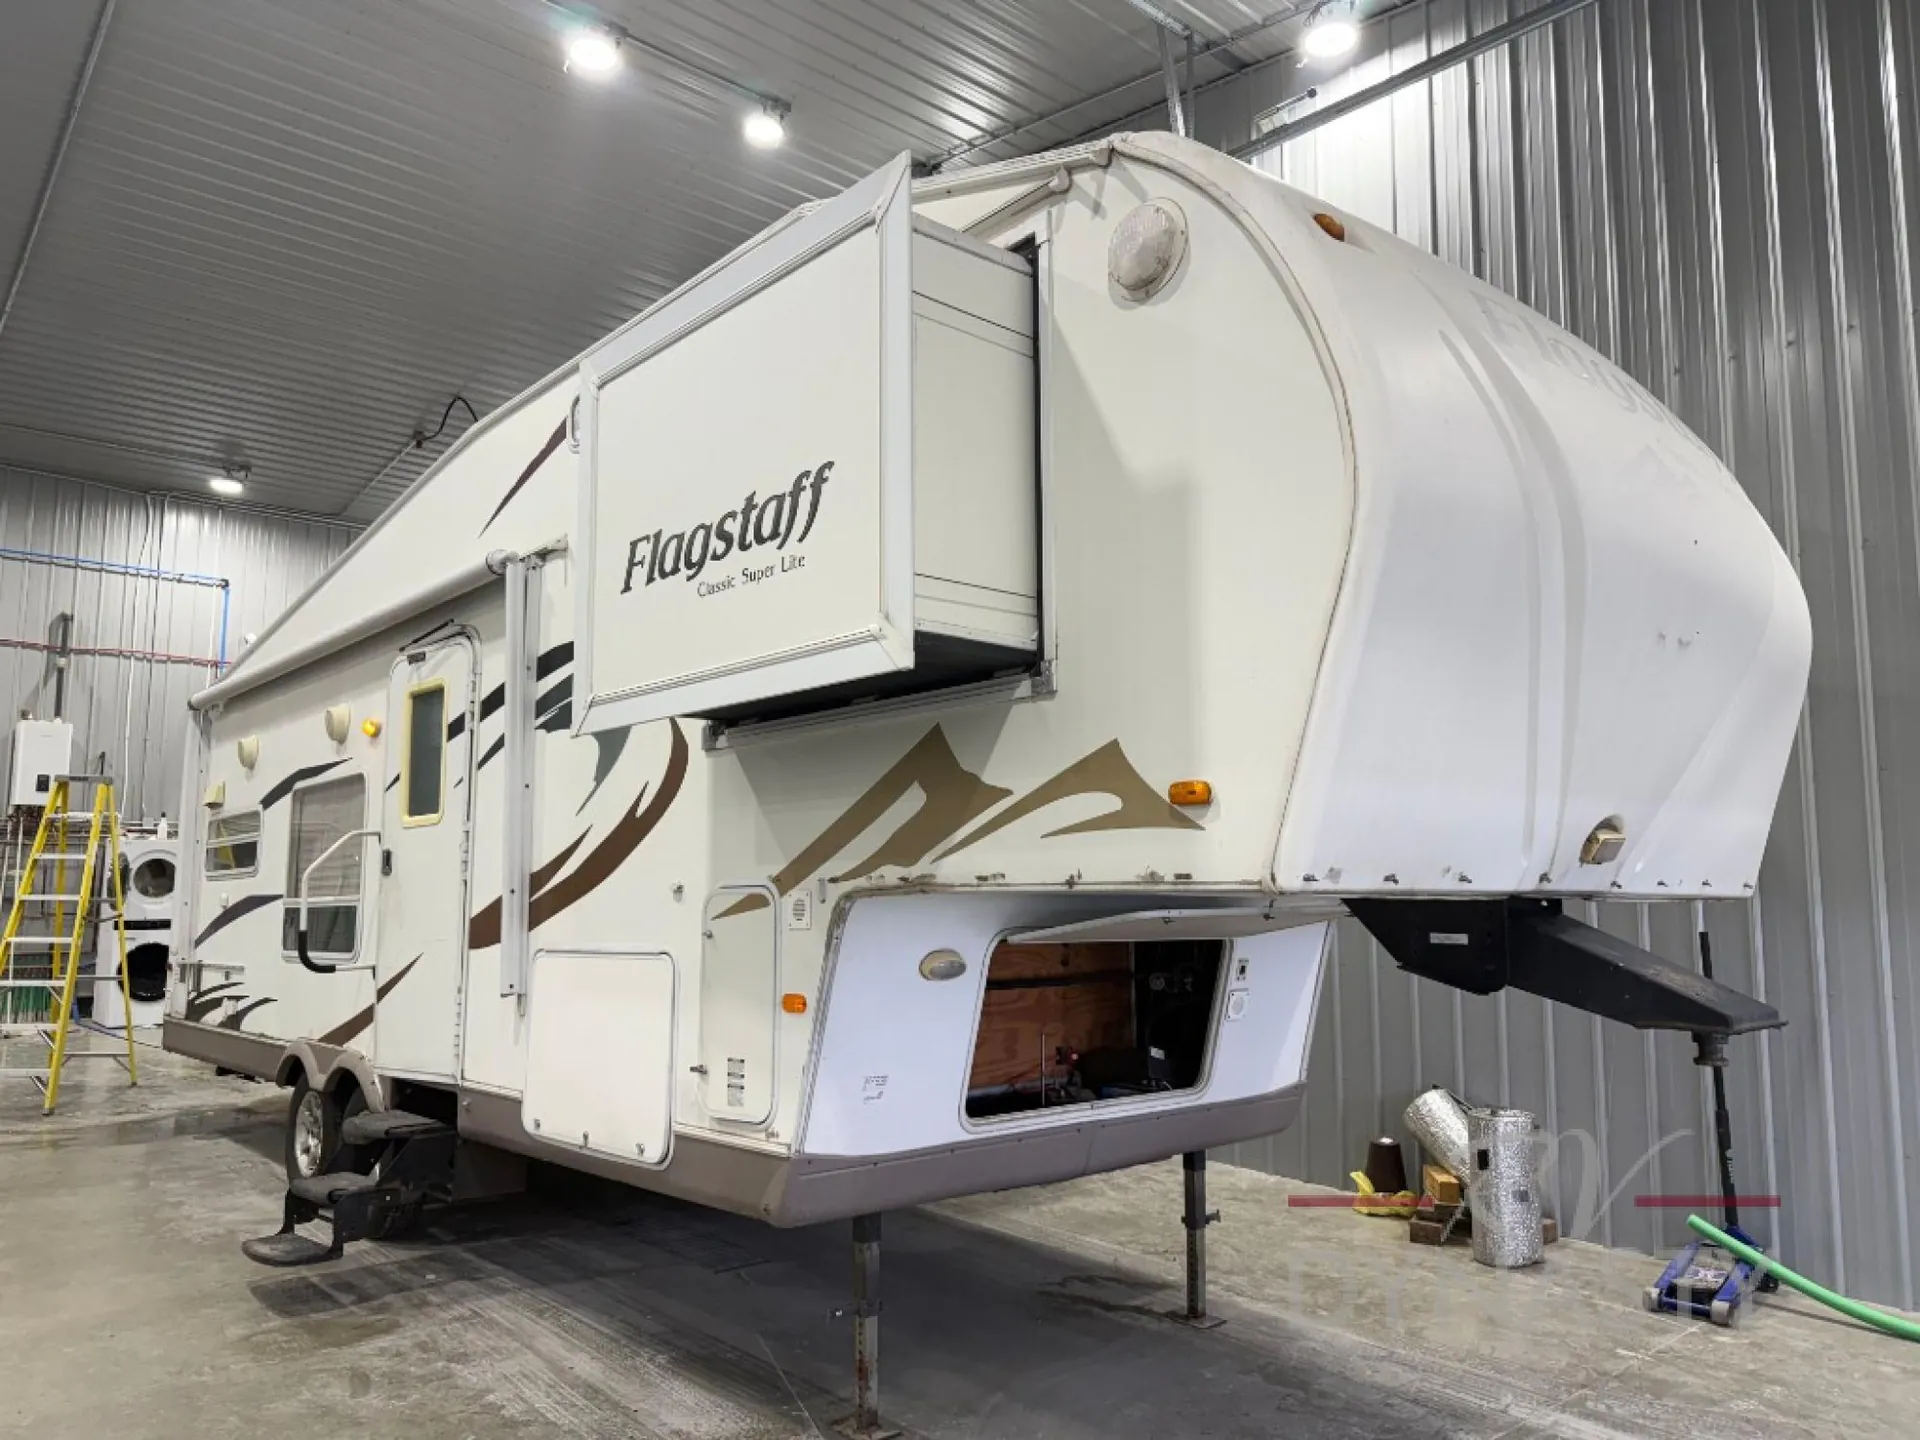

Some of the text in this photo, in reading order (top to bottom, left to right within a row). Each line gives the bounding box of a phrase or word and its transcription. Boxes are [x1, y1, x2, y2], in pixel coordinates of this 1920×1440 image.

[620, 460, 835, 595] Flagstaff
[696, 554, 806, 599] Classic Super Lite
